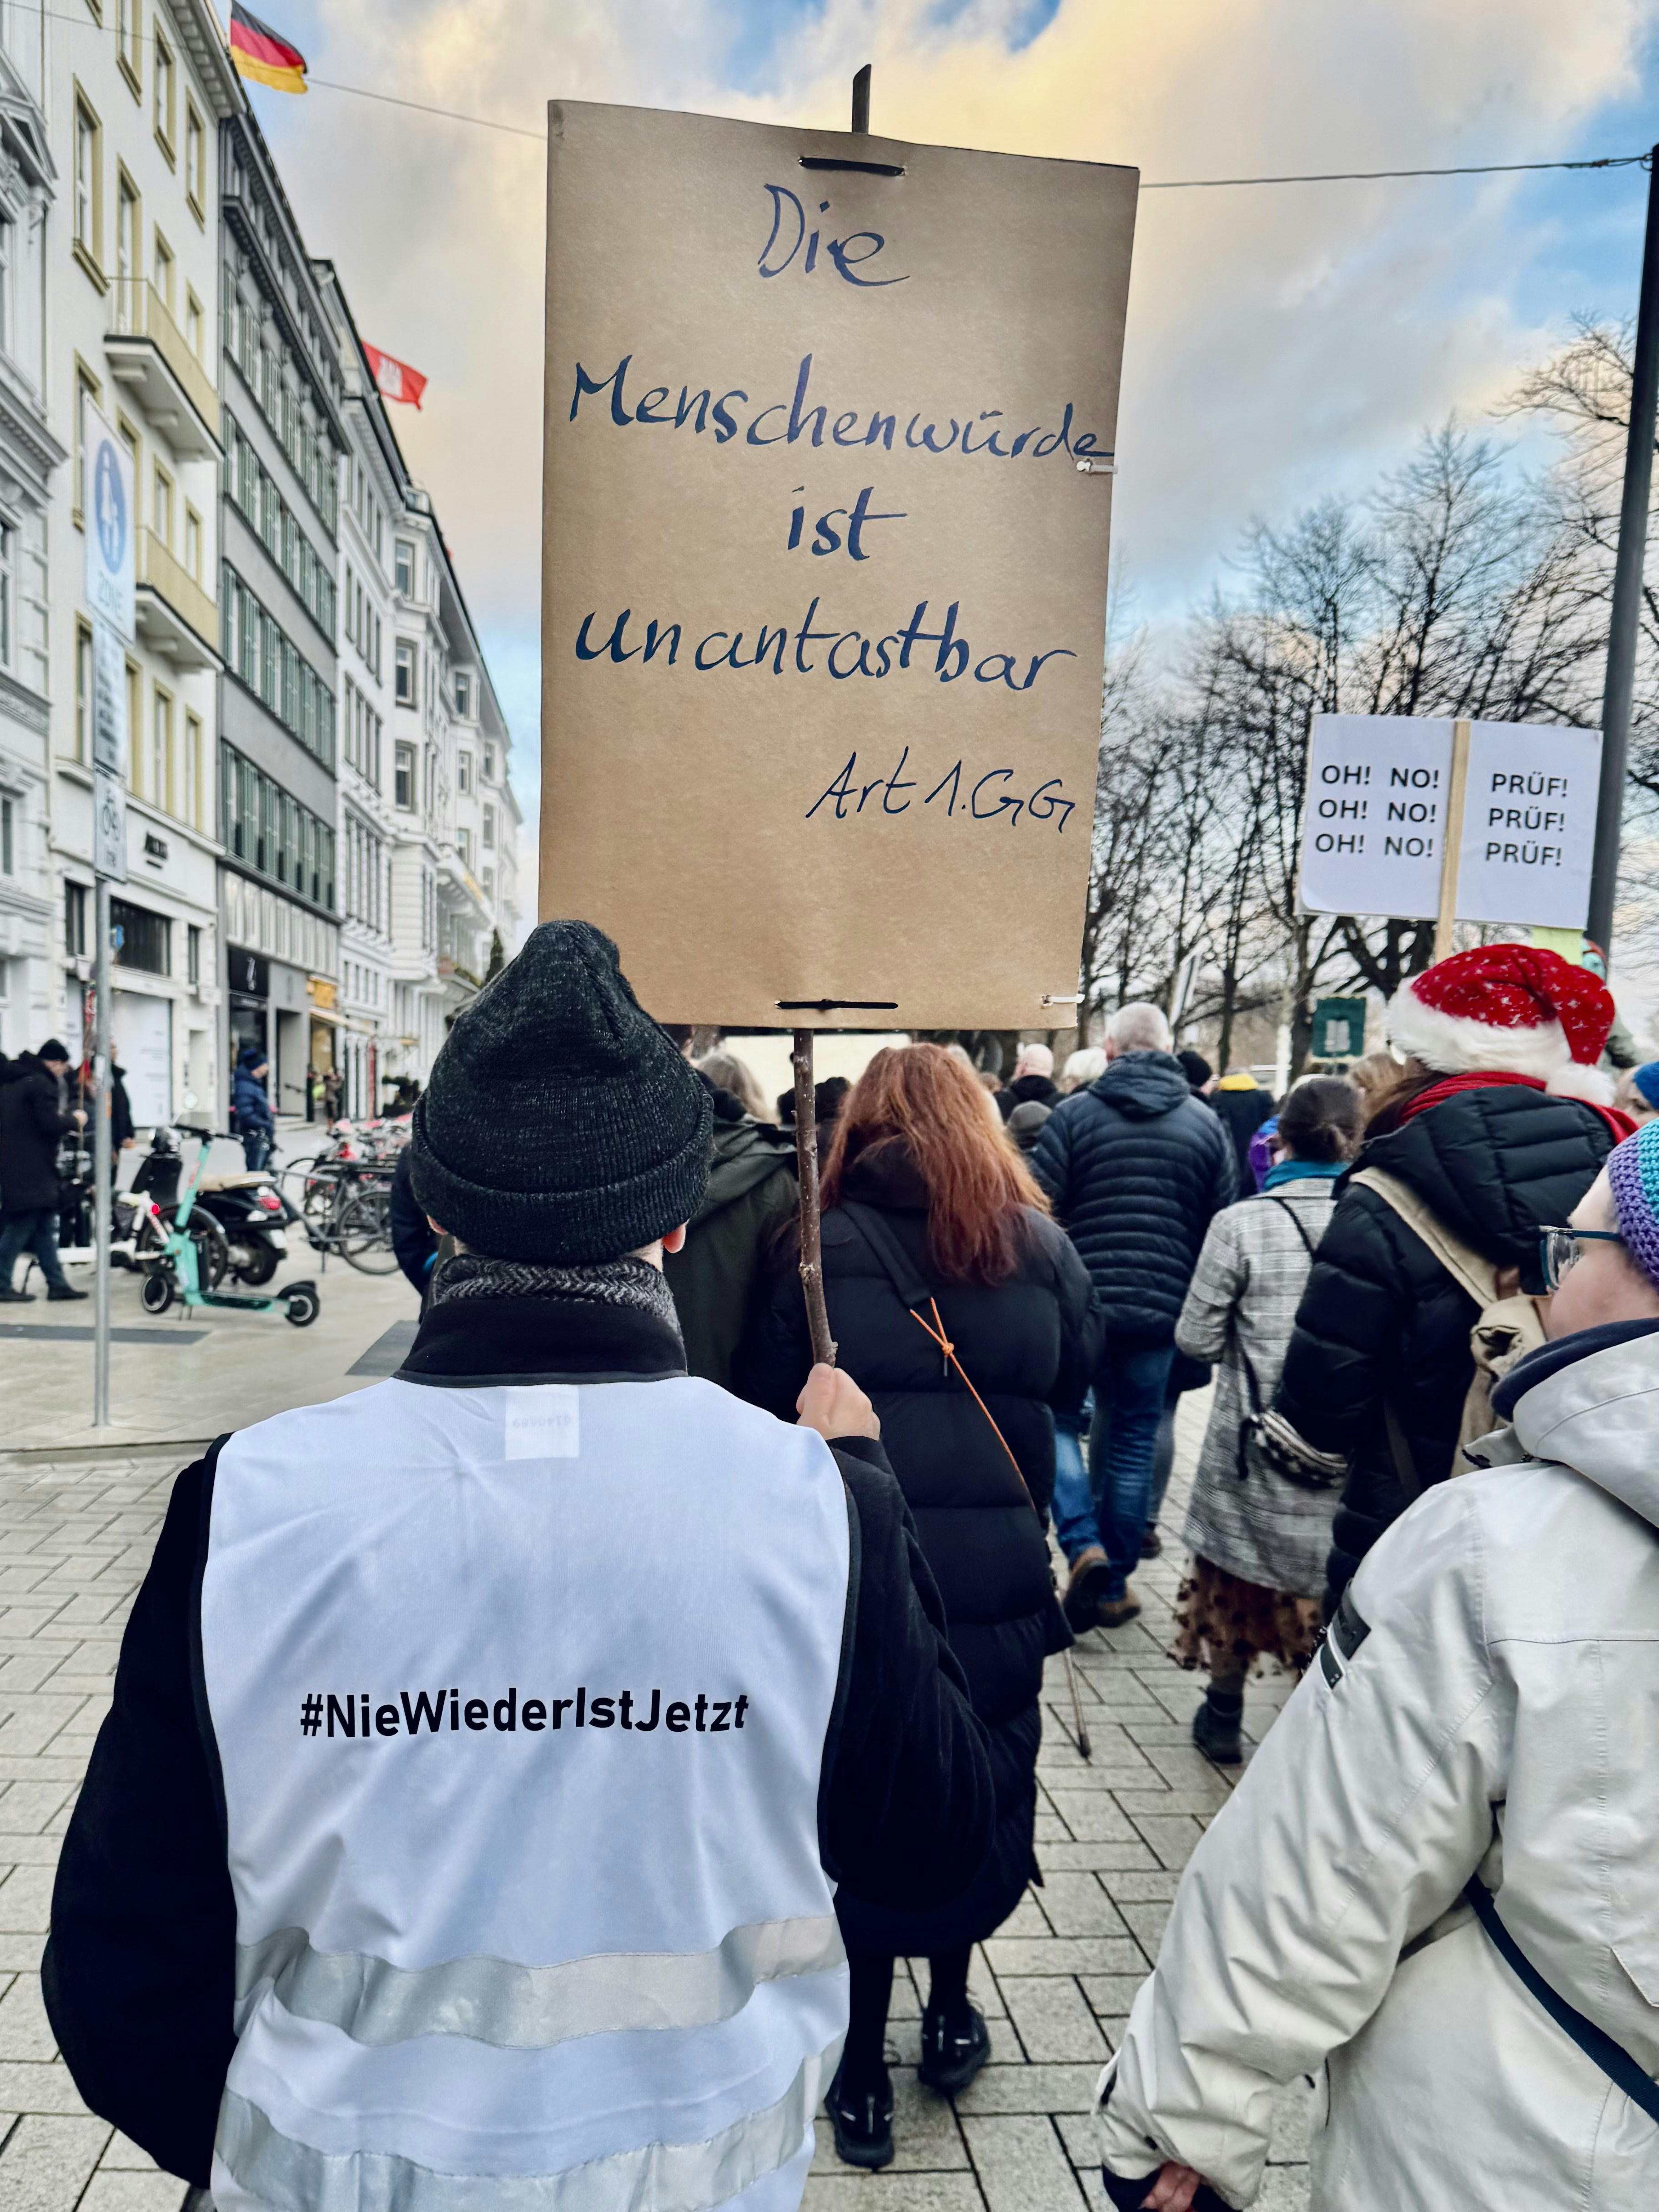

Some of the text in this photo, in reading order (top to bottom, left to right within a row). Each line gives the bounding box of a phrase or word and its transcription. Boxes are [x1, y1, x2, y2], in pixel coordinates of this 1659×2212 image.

[758, 183, 911, 287] Die
[569, 353, 1114, 460] Menschenwürde
[787, 485, 908, 561] ist
[575, 596, 1078, 691] unantastbar
[805, 746, 917, 819] Art
[1321, 764, 1439, 789] OH! NO!
[1491, 771, 1568, 798] PRÜF!
[1318, 799, 1436, 824] OH! NO!
[1488, 805, 1565, 833] PRÜF!
[1315, 833, 1433, 858] OH! NO!
[1485, 840, 1562, 867] PRÜF!
[300, 1687, 749, 1738] #NieWiederIstJetzt
